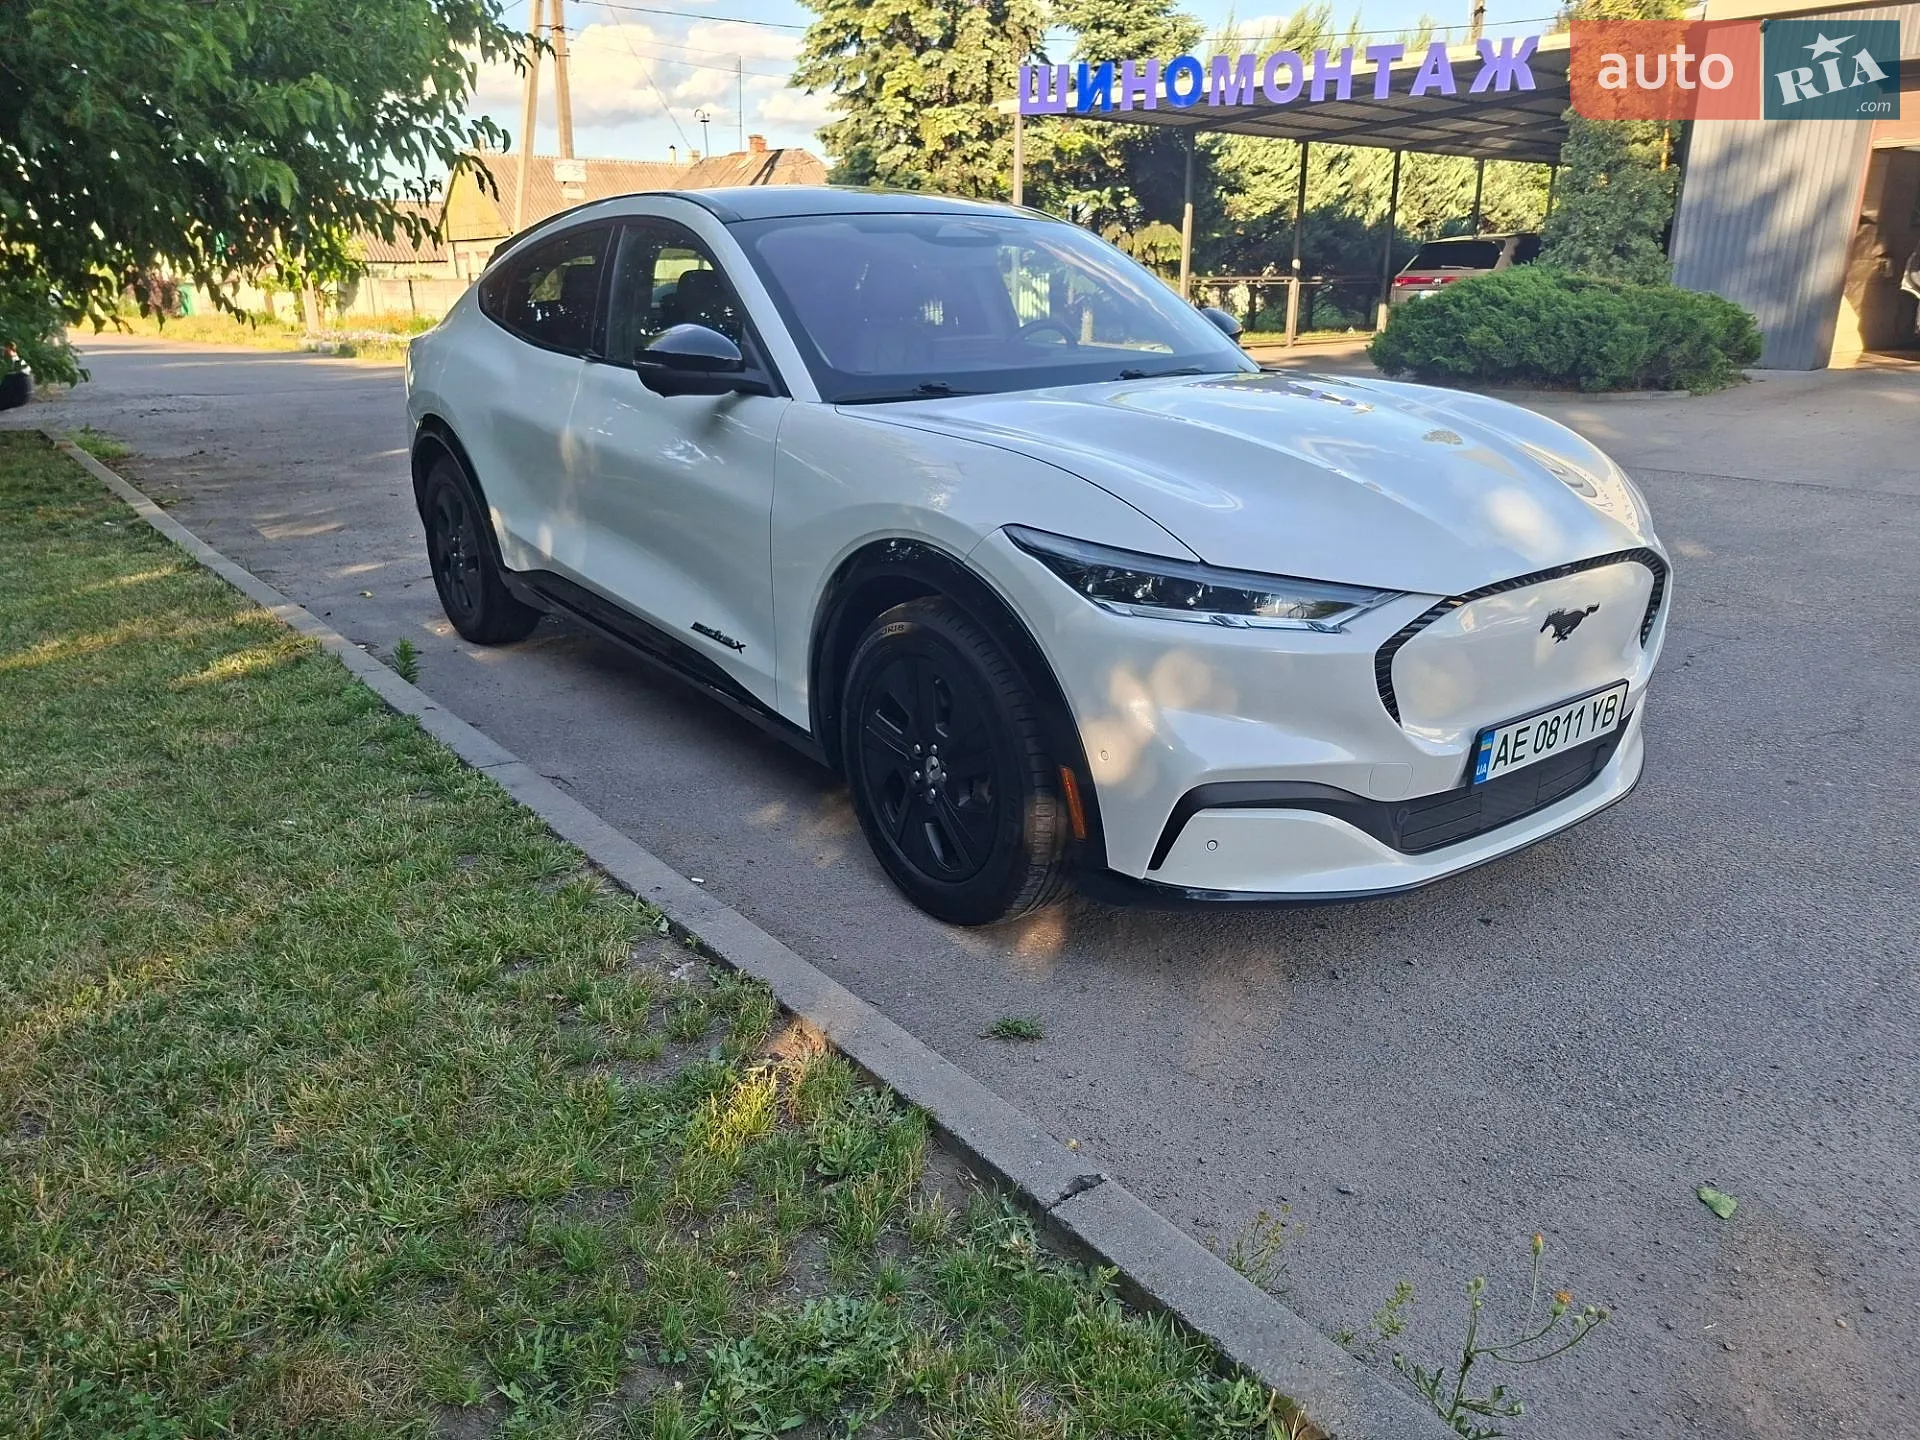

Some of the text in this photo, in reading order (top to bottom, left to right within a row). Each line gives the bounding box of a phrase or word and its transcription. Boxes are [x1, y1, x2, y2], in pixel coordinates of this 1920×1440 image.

[1019, 35, 1540, 115] ШИНОМОНТАЖ
[1476, 764, 1488, 776] UA
[1491, 694, 1618, 771] AE 0811 YB
